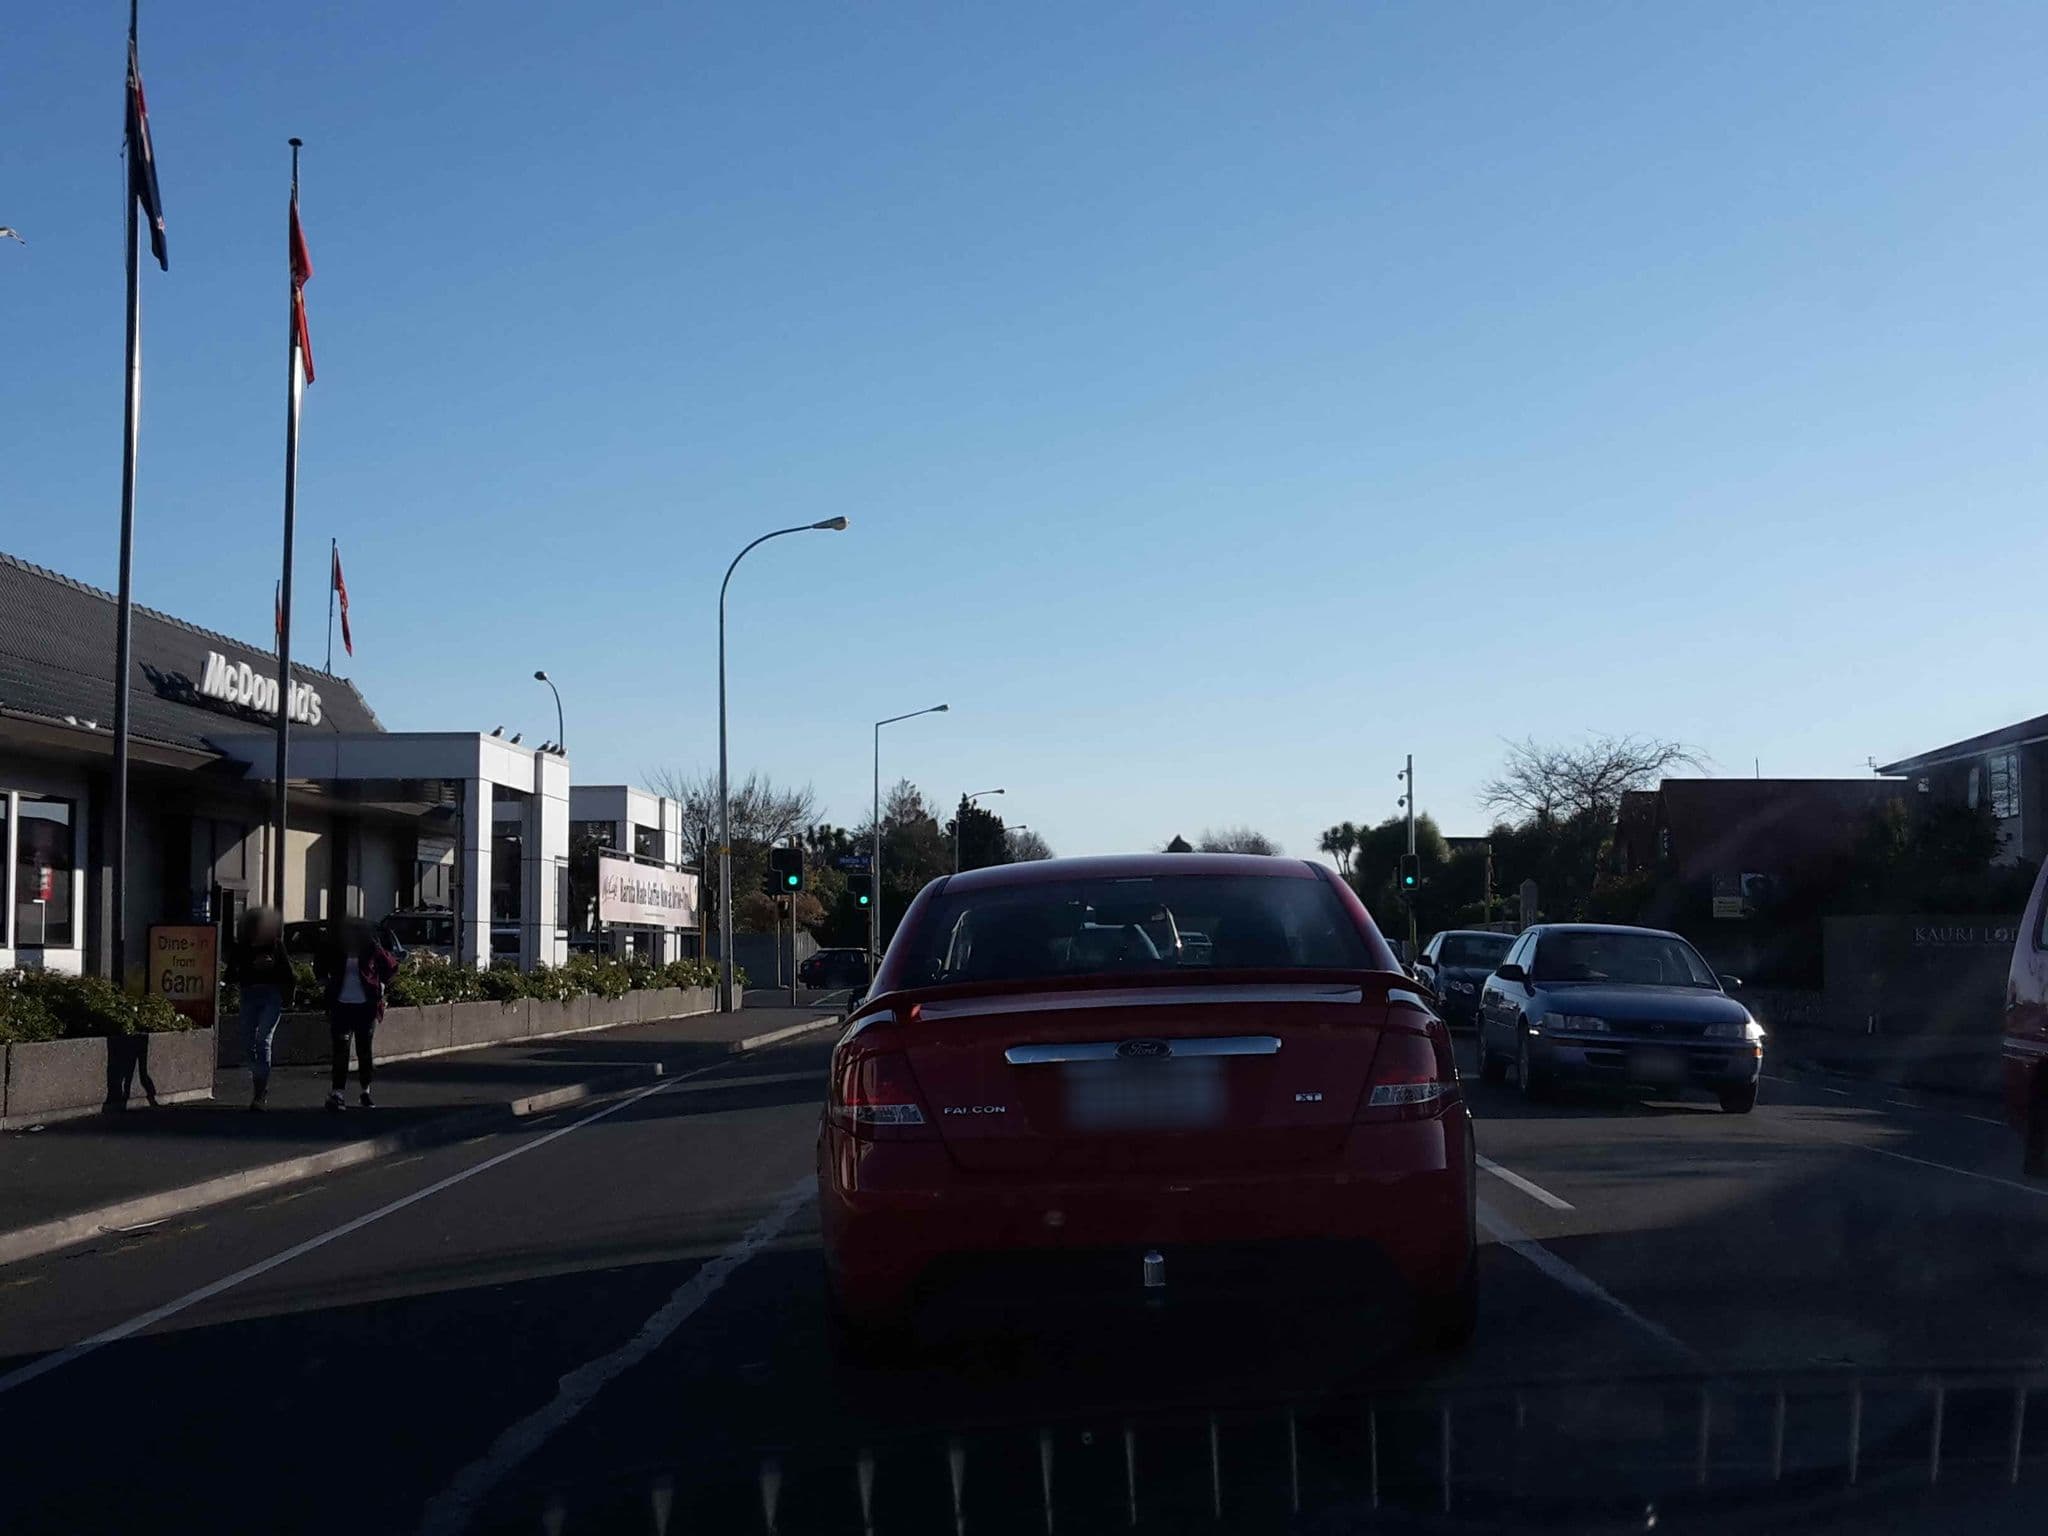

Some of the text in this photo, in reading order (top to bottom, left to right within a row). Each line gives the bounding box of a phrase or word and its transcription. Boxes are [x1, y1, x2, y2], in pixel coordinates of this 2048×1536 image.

[203, 650, 322, 726] McDonld's
[1913, 927, 1974, 942] KAURI
[172, 956, 195, 967] from
[162, 969, 203, 993] 6am
[1128, 1043, 1159, 1057] Ford
